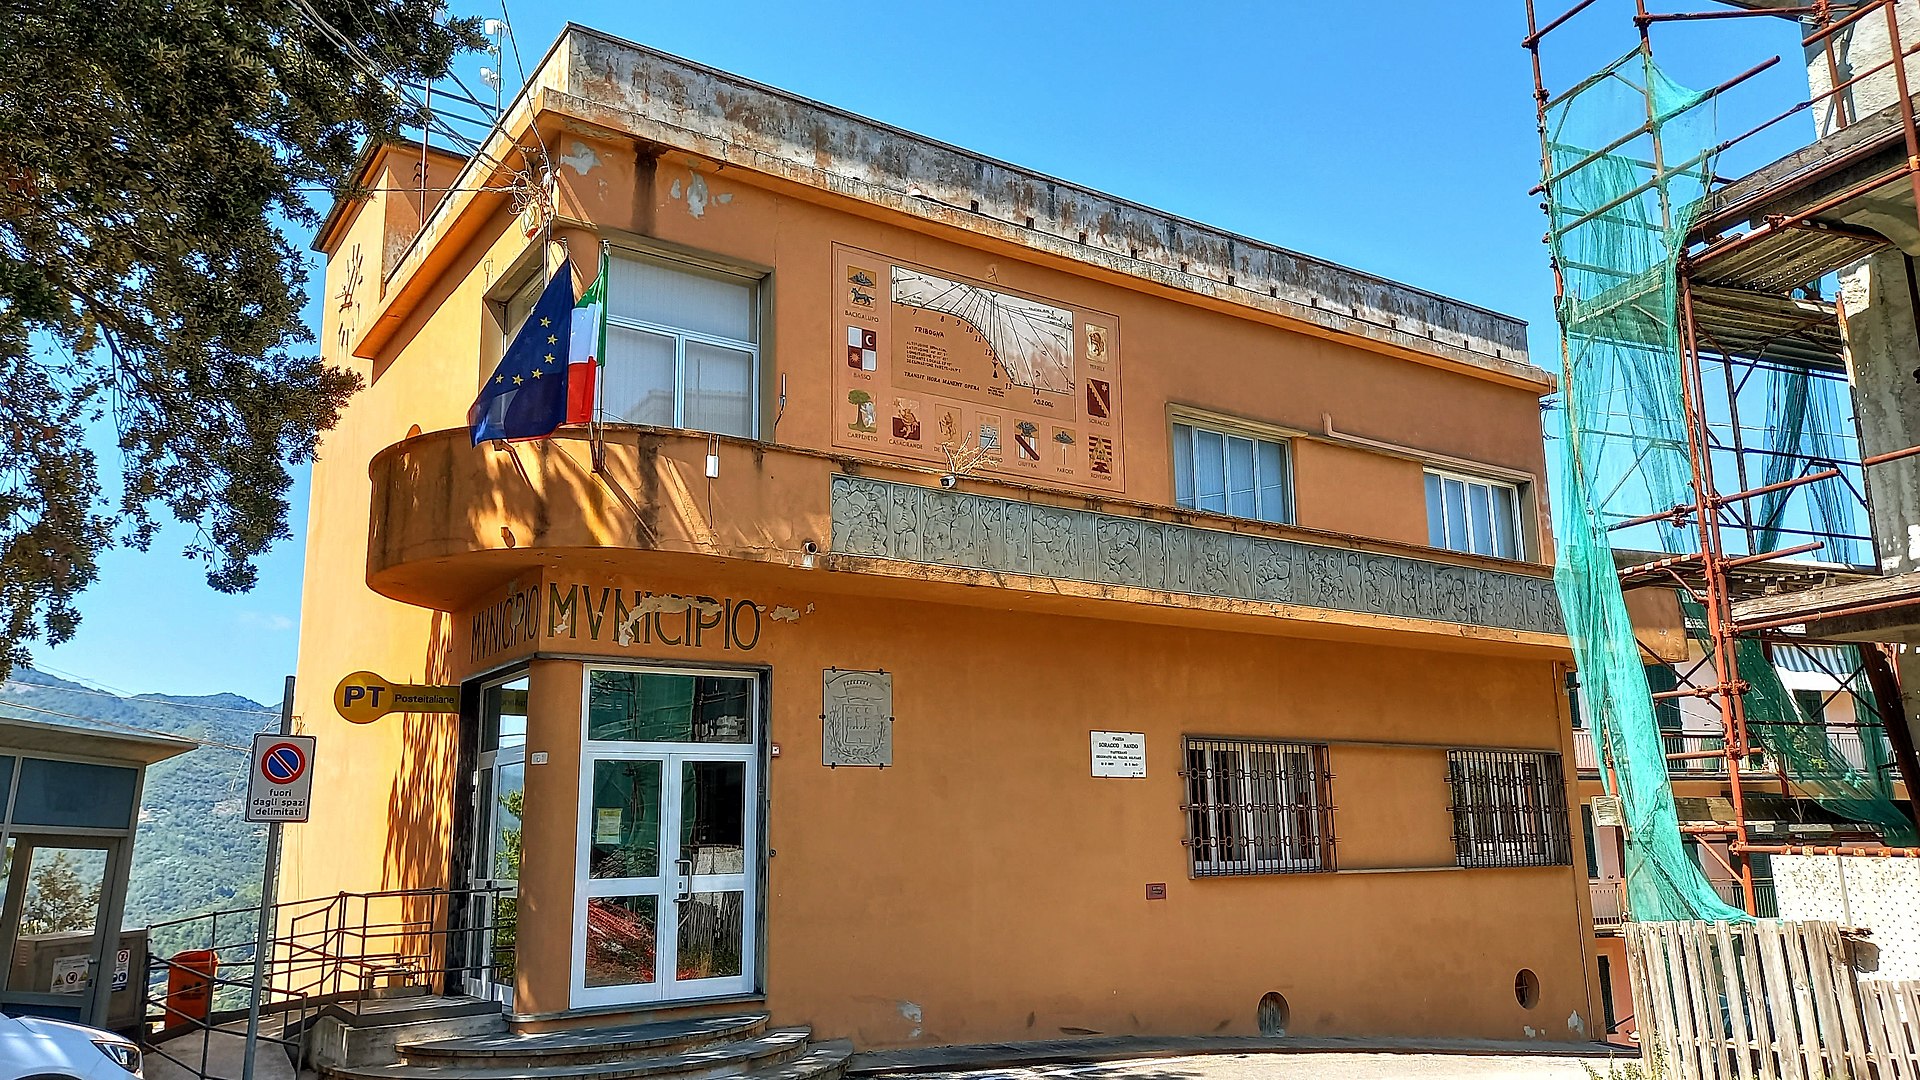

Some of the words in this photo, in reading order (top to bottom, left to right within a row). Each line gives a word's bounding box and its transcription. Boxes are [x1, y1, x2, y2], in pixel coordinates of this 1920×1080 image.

[845, 310, 879, 322] BACIGALUPO
[956, 319, 961, 327] 9
[914, 326, 945, 338] TRIBOGNA
[965, 325, 974, 333] 10
[974, 335, 982, 343] 11
[984, 348, 992, 356] 12
[904, 371, 925, 380] TRANSIT
[926, 375, 941, 383] HORA
[942, 378, 963, 388] MANENT
[964, 383, 980, 391] OPERA
[1005, 382, 1012, 390] 13
[1032, 386, 1040, 396] 14
[888, 438, 923, 450] CASAGRANDE
[344, 685, 386, 708] PT
[394, 693, 456, 705] Posteitaliane
[269, 788, 292, 797] fuori
[253, 797, 278, 808] dagli
[281, 798, 306, 808] spazi
[255, 807, 302, 816] delimitati
